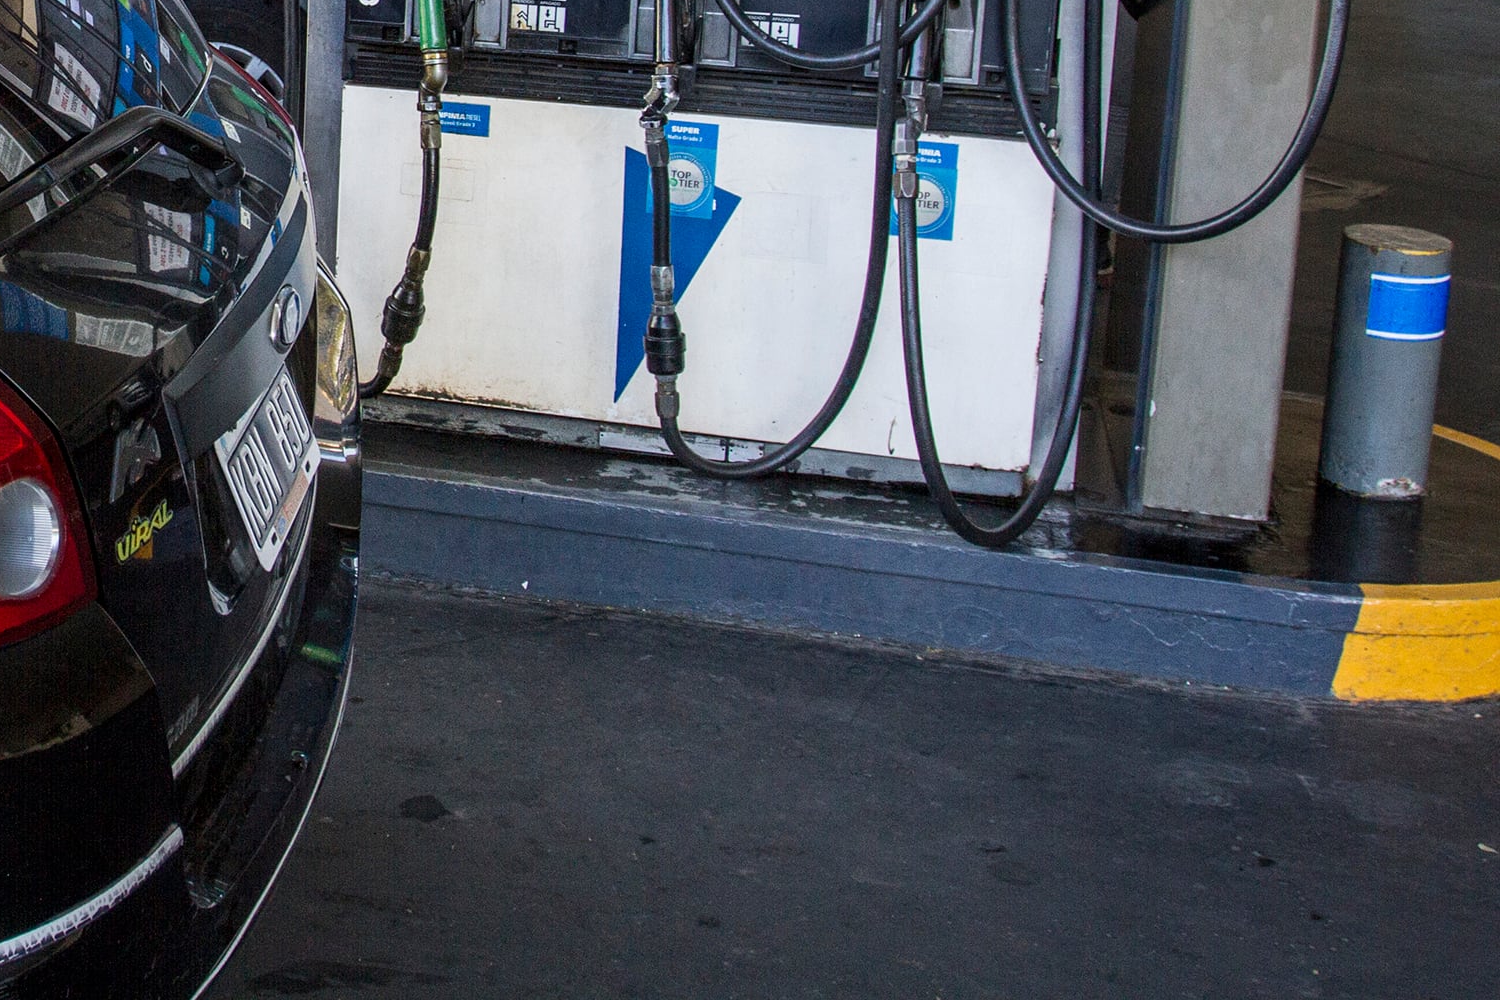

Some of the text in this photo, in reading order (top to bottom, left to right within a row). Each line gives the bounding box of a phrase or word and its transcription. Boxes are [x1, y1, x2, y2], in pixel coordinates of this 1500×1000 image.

[671, 125, 700, 134] SUPER
[671, 170, 692, 178] TOP
[678, 180, 700, 188] TIER
[918, 192, 930, 200] OP
[230, 423, 284, 542] KBN
[265, 373, 312, 473] 850
